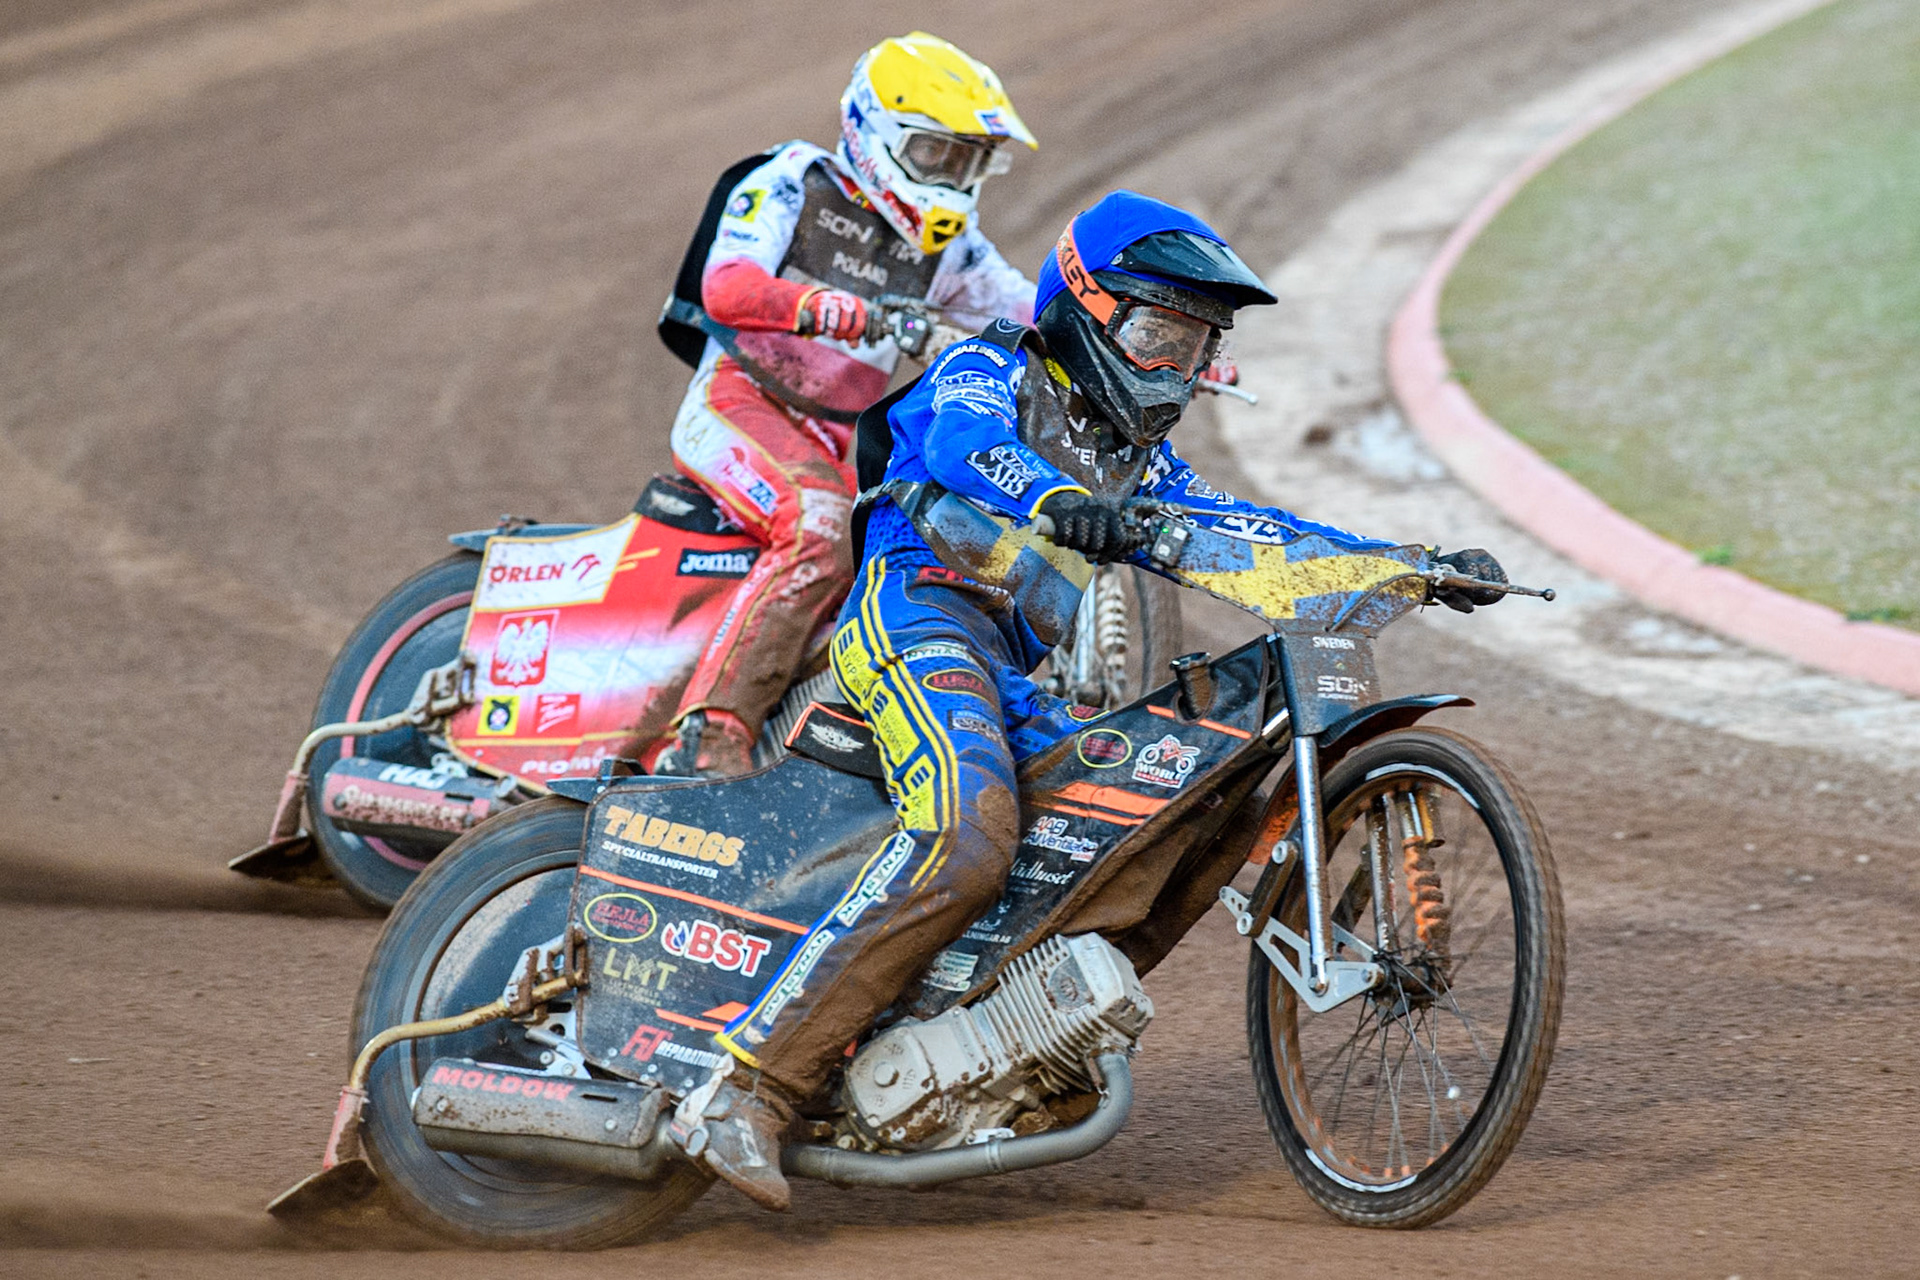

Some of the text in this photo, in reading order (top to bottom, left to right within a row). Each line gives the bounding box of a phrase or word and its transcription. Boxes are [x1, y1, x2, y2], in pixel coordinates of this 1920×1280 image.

[818, 207, 875, 244] SON
[832, 250, 889, 287] POLAND
[490, 564, 565, 583] ORLEN
[1312, 636, 1356, 650] SWEDEN
[604, 805, 746, 867] TABERGS
[687, 921, 769, 976] BST
[602, 947, 679, 991] LMT
[432, 1066, 575, 1102] MOLDOW
